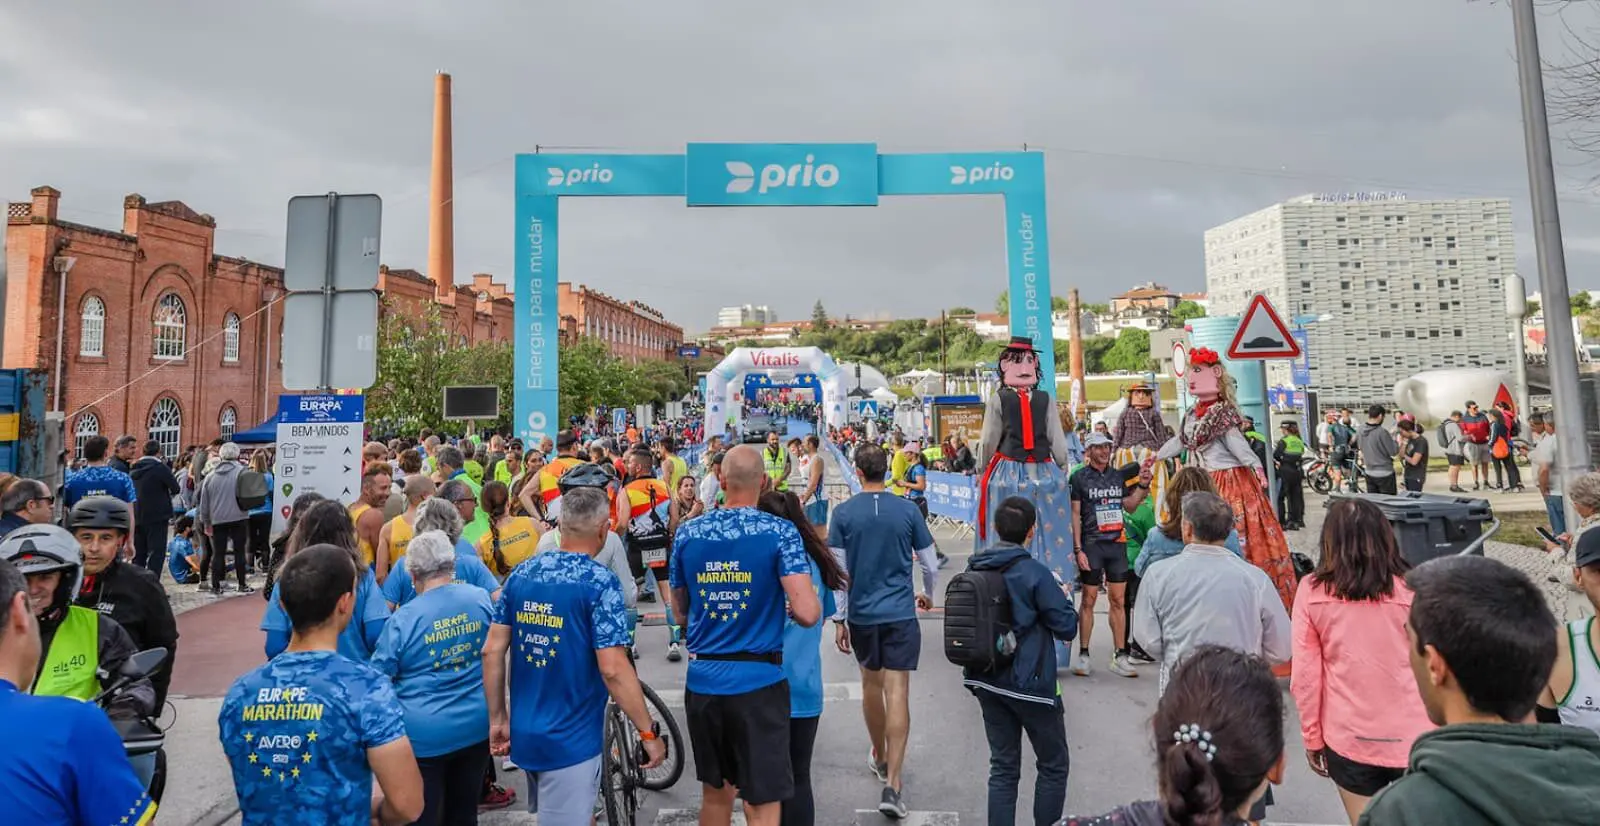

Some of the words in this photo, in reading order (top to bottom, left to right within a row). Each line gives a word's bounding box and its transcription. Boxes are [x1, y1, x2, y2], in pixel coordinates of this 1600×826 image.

[566, 161, 613, 187] prio
[758, 153, 839, 194] prio
[969, 160, 1014, 185] prio
[528, 216, 542, 275] mudar
[1018, 212, 1034, 267] mudar
[530, 278, 545, 316] para
[1024, 272, 1039, 311] para
[527, 324, 545, 389] Energia
[750, 350, 800, 367] Vitalis
[291, 425, 349, 437] BEM-VINDOS
[697, 571, 752, 584] MARATHON
[424, 620, 482, 644] MARATHON
[516, 611, 564, 629] MARATHON
[242, 703, 324, 721] MARATHON
